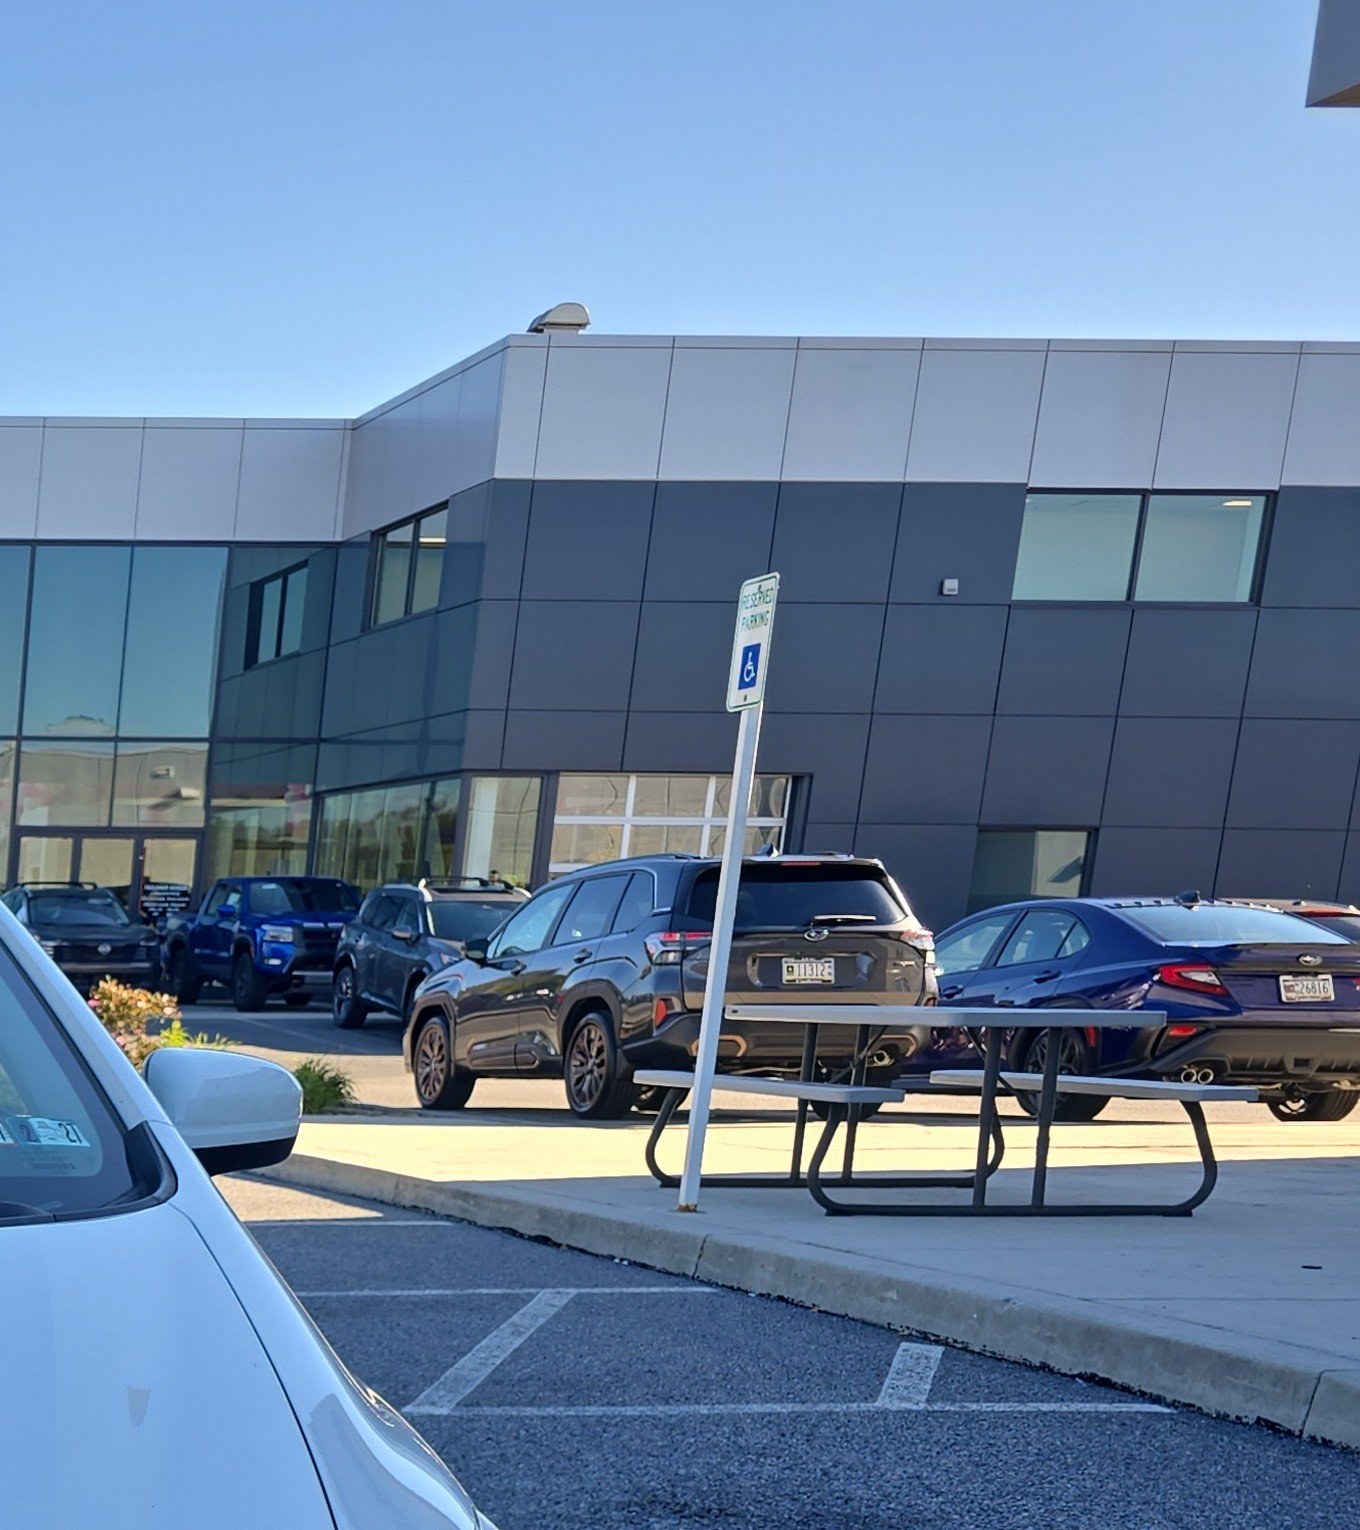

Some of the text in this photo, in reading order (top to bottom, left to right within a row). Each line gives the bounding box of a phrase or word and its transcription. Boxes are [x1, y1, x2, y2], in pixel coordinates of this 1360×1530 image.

[741, 587, 774, 610] RESERVED
[740, 611, 769, 631] PARKING
[58, 1122, 83, 1144] 27
